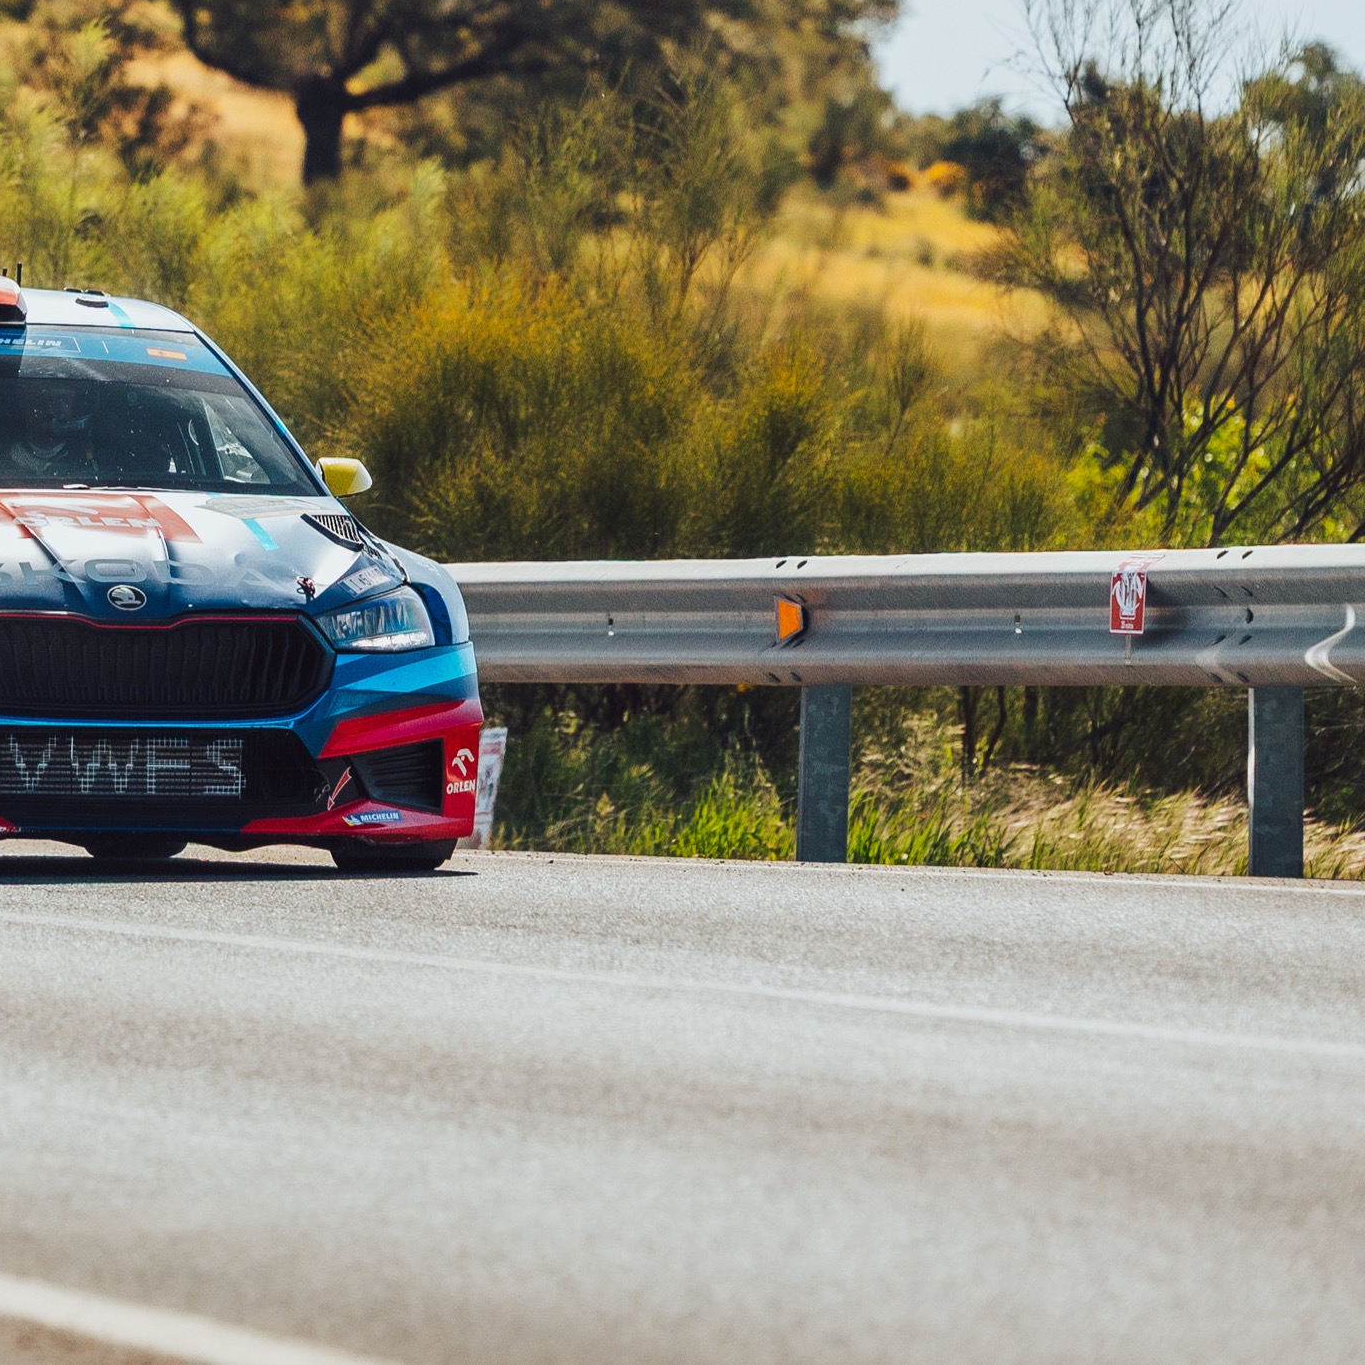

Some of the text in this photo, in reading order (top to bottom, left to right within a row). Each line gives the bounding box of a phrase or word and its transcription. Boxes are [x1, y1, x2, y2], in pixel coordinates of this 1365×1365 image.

[13, 516, 163, 529] ORLEN
[446, 779, 476, 795] ORLEN
[360, 811, 399, 822] MICHELIN
